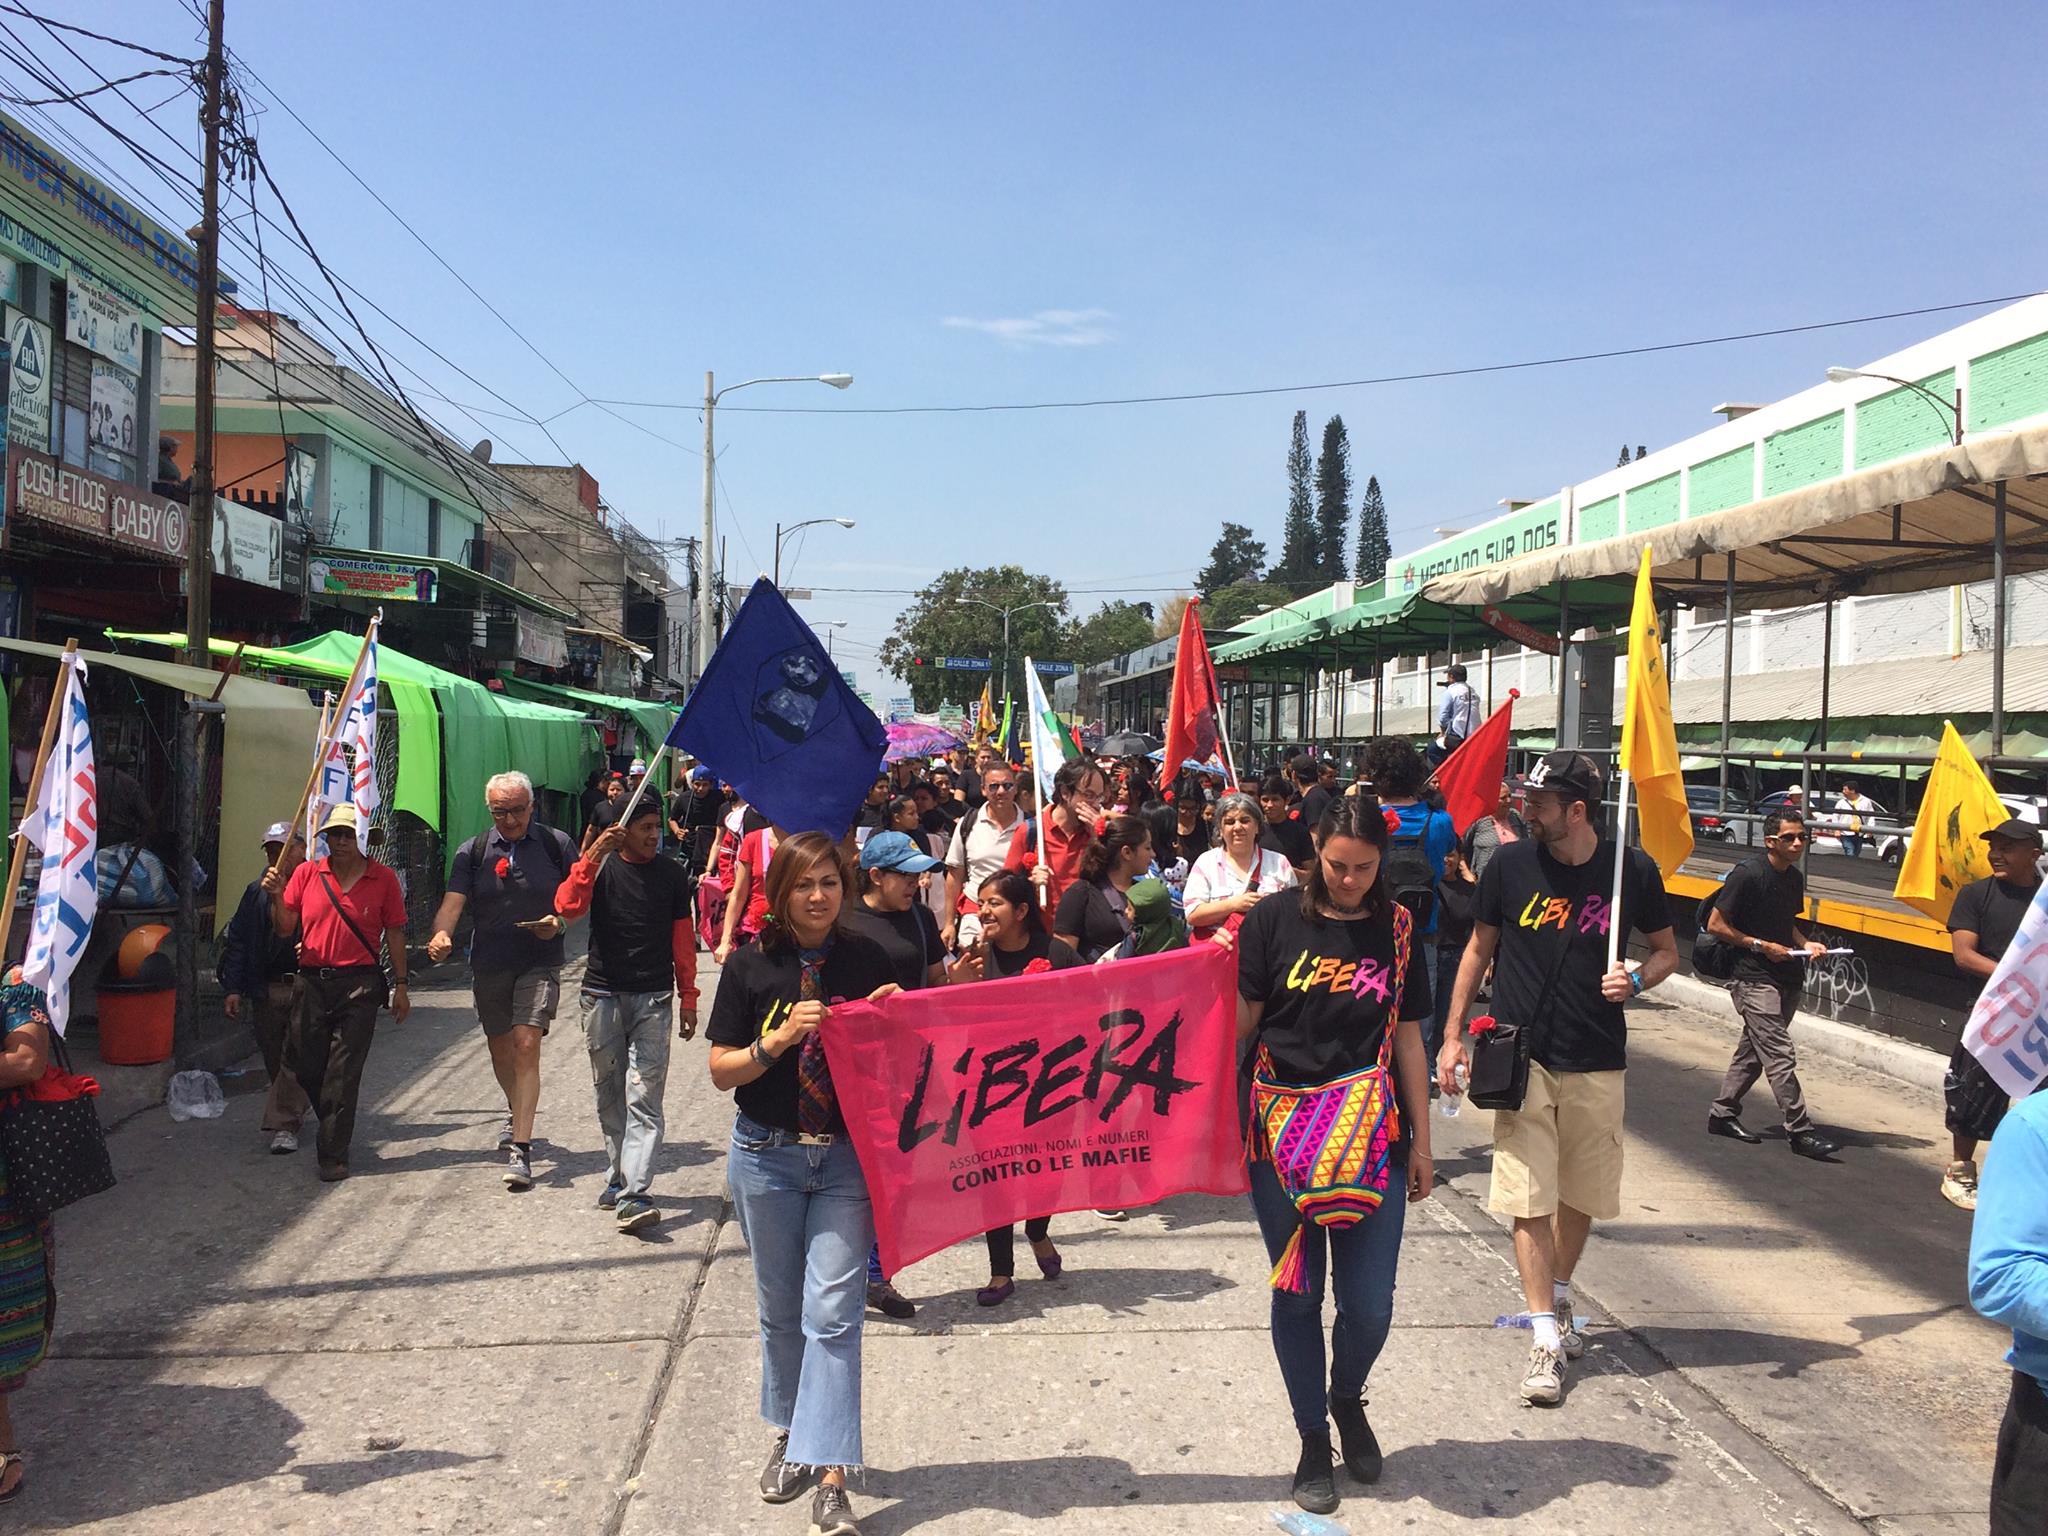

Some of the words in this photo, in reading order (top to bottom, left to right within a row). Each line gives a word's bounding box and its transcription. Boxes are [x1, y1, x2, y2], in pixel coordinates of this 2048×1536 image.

[21, 345, 35, 371] AA
[113, 496, 162, 543] GABY
[1486, 535, 1516, 564] SUR
[1523, 519, 1558, 554] DOS
[329, 559, 392, 572] COMERCIAL
[395, 564, 416, 574] J&J
[1037, 663, 1054, 672] CALLE
[1046, 1137, 1082, 1152] NOMI
[1086, 1135, 1093, 1147] E
[1097, 1129, 1150, 1145] NUMERI
[951, 1158, 1042, 1193] CONTRO
[1049, 1154, 1074, 1173] LE
[1081, 1145, 1152, 1168] MAFIE
